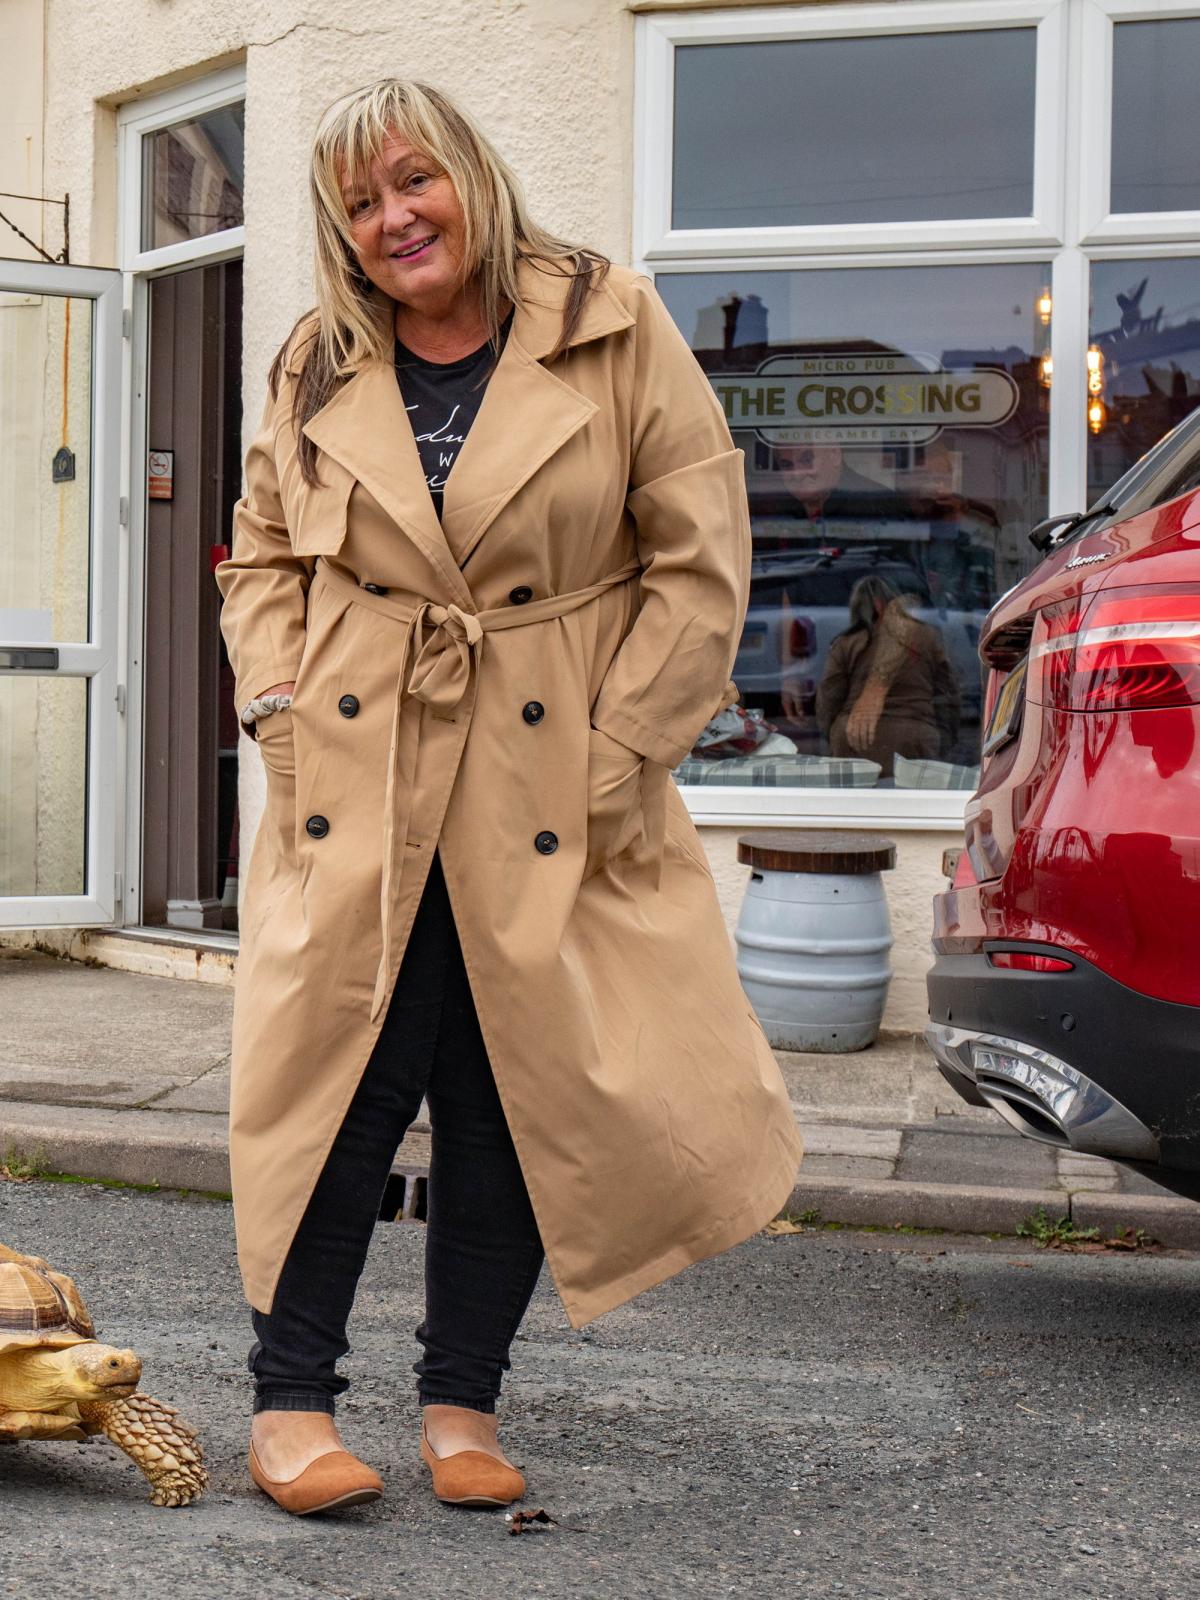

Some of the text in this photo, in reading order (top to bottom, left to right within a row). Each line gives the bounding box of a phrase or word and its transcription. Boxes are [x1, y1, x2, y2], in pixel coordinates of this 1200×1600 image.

[803, 359, 896, 372] MICRO PUB
[717, 383, 981, 418] THE CROSSING
[778, 428, 919, 441] MORECAMBE BAY
